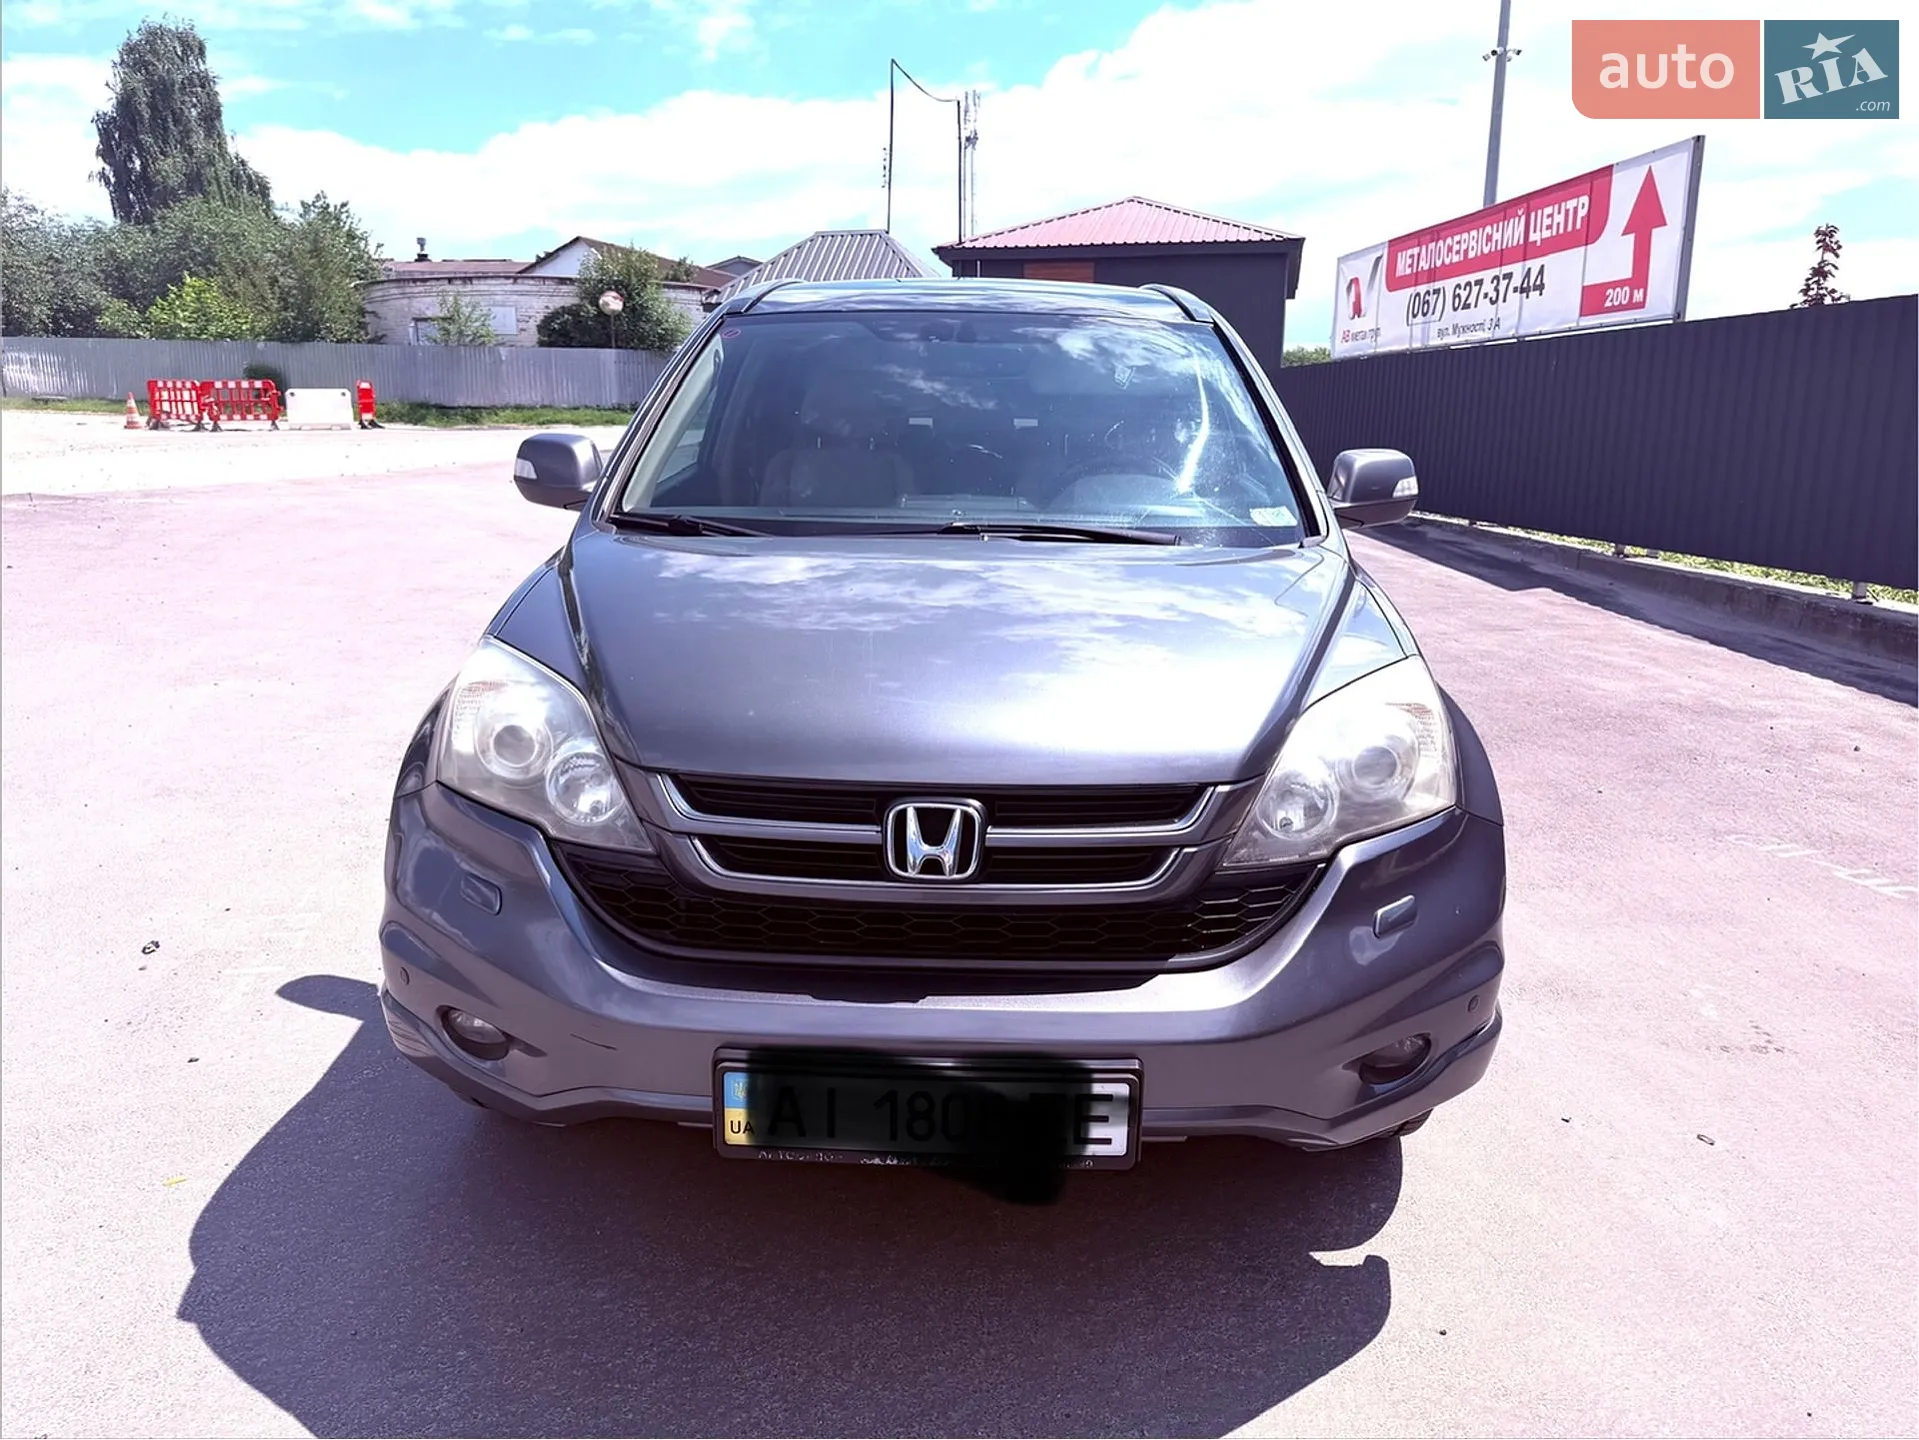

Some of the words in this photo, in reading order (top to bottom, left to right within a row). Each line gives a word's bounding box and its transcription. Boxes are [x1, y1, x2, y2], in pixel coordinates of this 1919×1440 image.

[1396, 208, 1526, 277] МЕТАЛОСЕРВІСНИЙ
[1529, 195, 1589, 246] ЦЕНТР
[1406, 286, 1446, 327] (067)
[1452, 264, 1545, 312] 627-37-44
[1604, 286, 1630, 307] 200
[730, 1120, 755, 1135] UA
